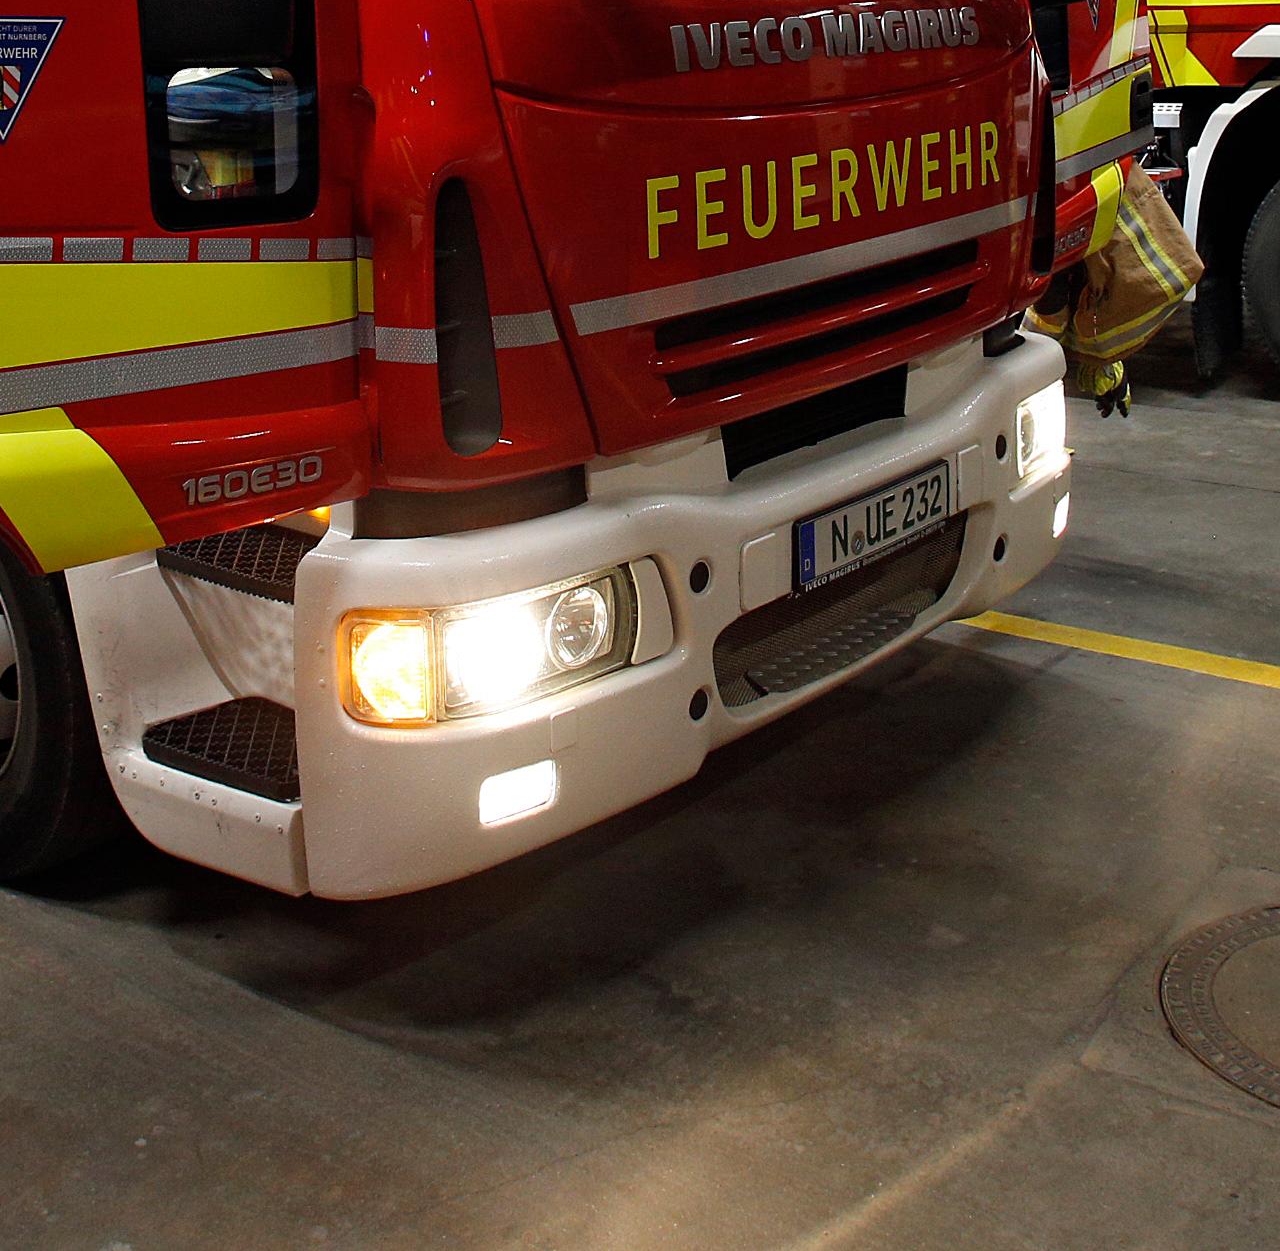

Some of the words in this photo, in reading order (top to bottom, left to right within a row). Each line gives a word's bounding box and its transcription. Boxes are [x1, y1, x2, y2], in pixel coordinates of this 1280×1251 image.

[670, 16, 813, 72] IVECO
[821, 6, 979, 57] MAGIRUS
[646, 121, 1000, 259] FEUERWEHR
[182, 456, 322, 506] 160E30
[804, 558, 811, 571] D
[831, 514, 849, 563] N
[866, 494, 897, 545] UE
[902, 474, 942, 530] 232
[805, 574, 828, 592] IVECO
[829, 562, 861, 582] MAGIRUS
